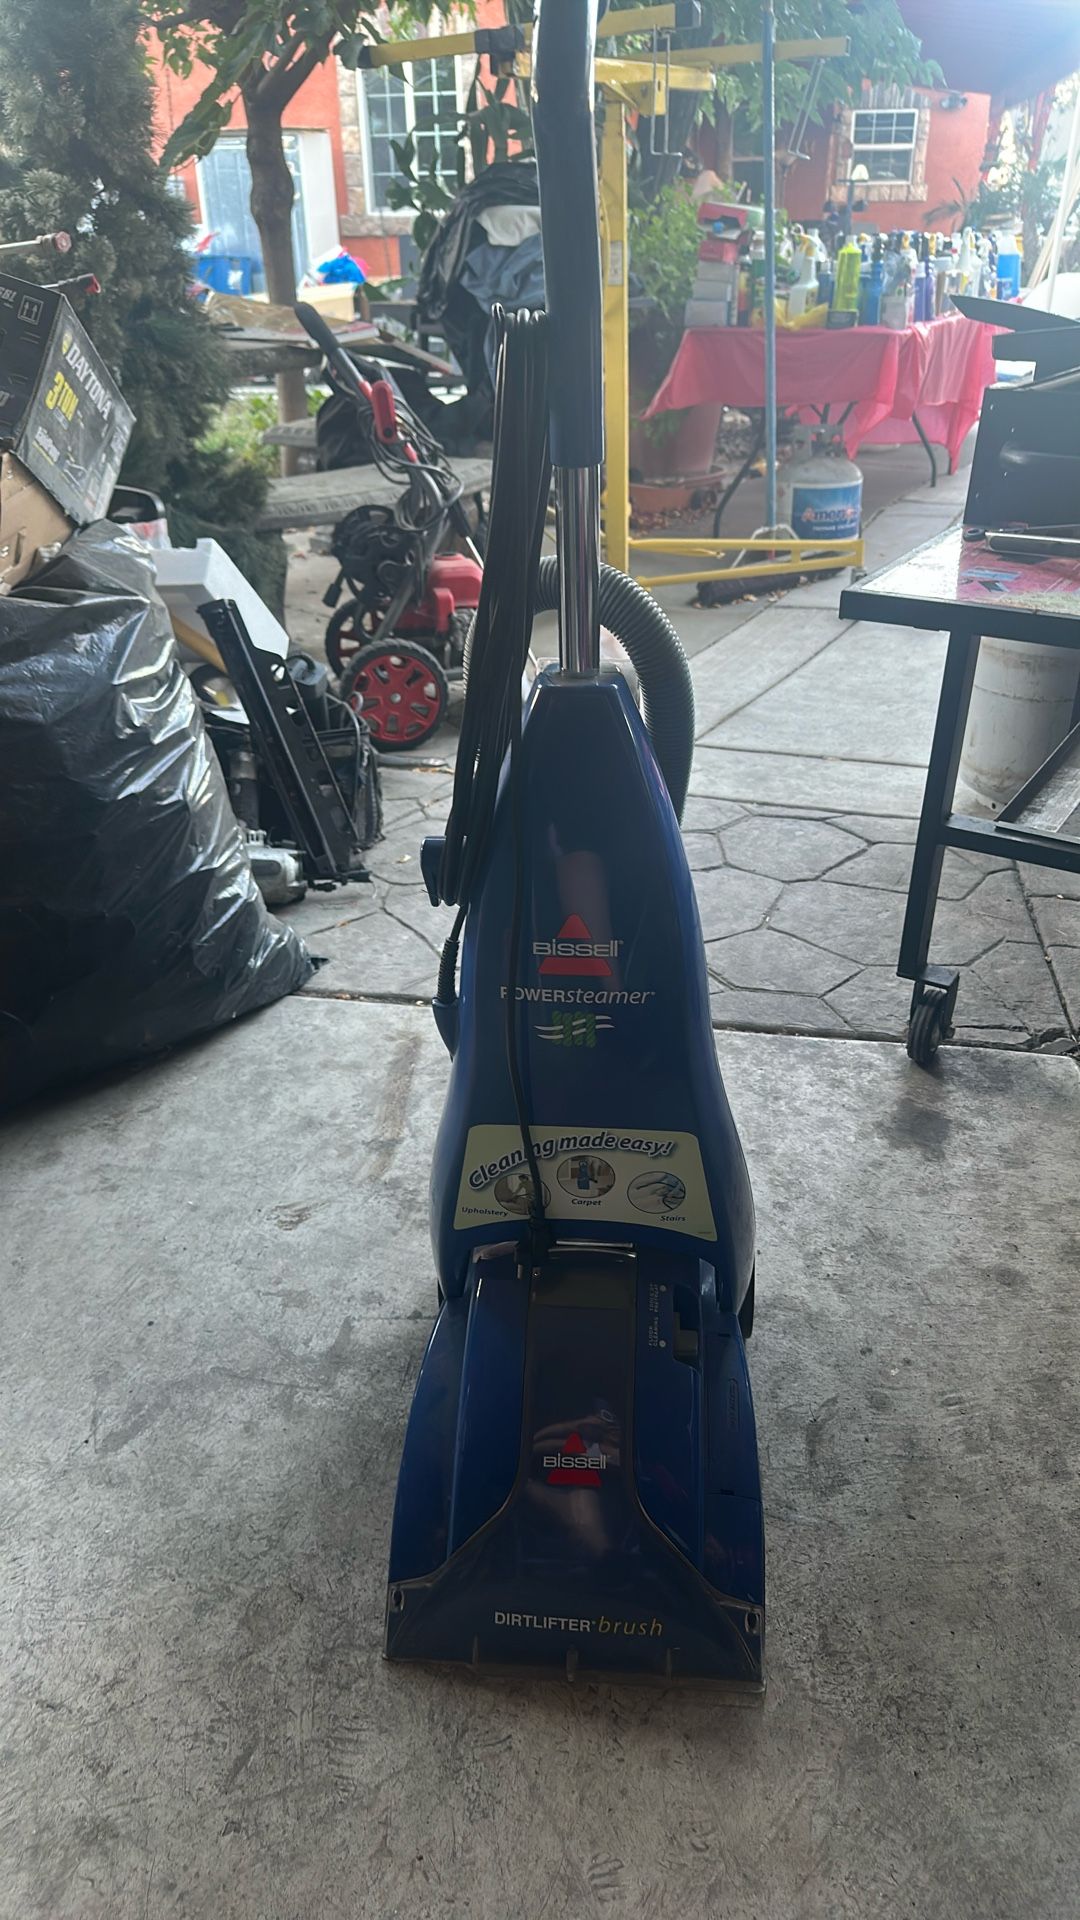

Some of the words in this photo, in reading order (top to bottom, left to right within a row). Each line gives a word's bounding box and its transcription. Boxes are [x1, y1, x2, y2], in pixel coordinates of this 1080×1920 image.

[64, 341, 112, 420] DAYTONA
[57, 380, 79, 421] TON
[468, 1138, 556, 1190] Cleanng
[558, 1131, 617, 1150] made
[618, 1137, 674, 1157] easy!
[461, 1206, 509, 1217] Upholstery
[571, 1198, 602, 1207] Carpet
[494, 1611, 592, 1633] DIRTLIFTER
[598, 1615, 664, 1637] brush
